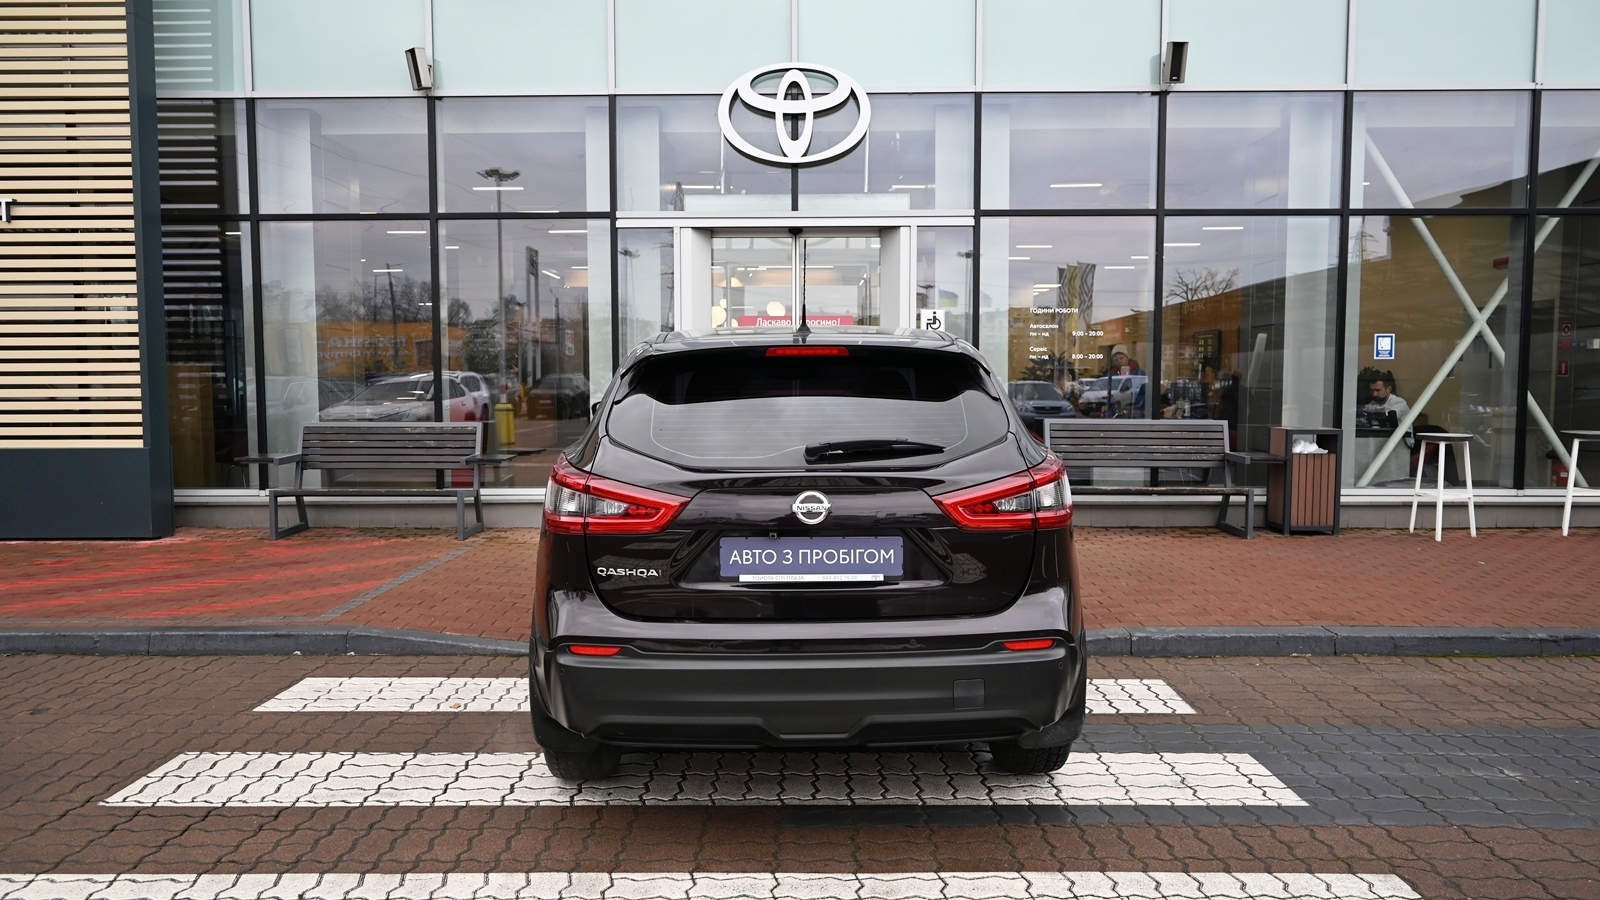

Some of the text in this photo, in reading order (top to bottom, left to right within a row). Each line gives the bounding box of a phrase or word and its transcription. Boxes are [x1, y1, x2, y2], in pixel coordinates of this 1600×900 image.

[756, 318, 841, 326] Ласкаво росимо!
[729, 549, 777, 565] АВТО
[799, 549, 895, 565] ПРОБІГОМ
